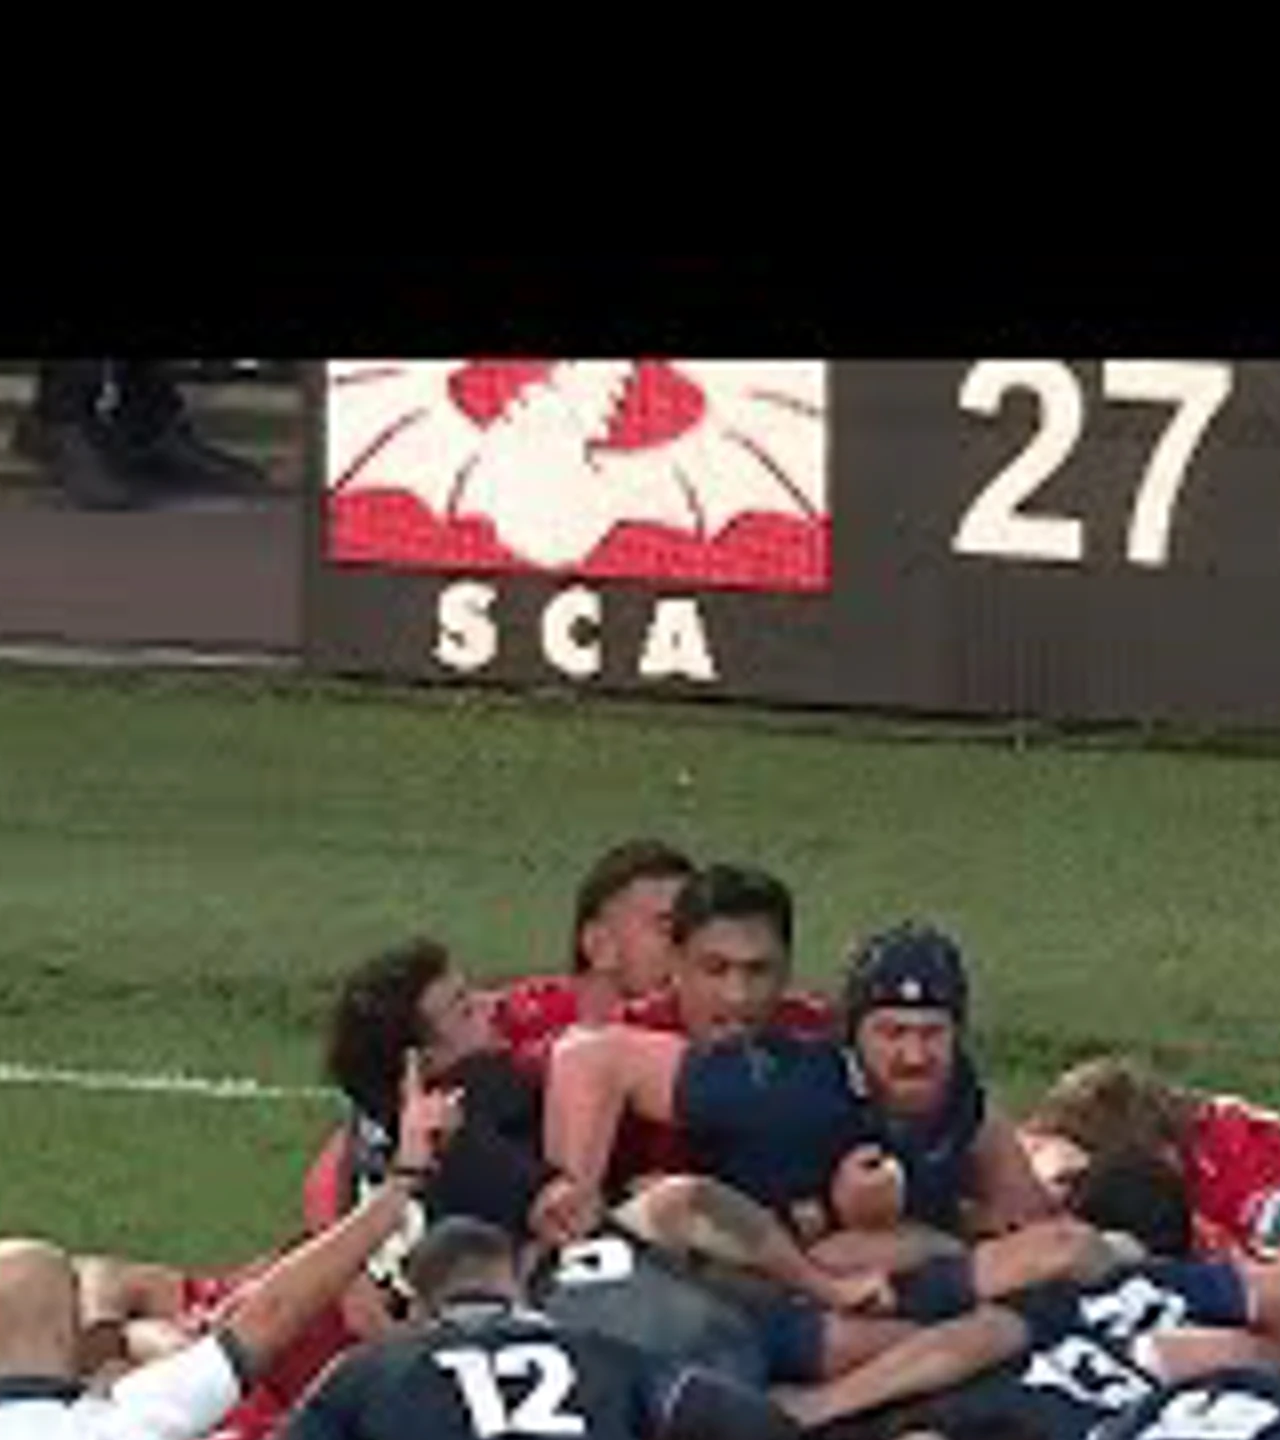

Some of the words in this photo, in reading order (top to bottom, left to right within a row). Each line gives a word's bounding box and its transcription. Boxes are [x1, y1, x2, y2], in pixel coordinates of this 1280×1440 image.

[952, 358, 1233, 567] 27
[433, 581, 718, 681] SCA
[433, 1344, 587, 1439] 12
